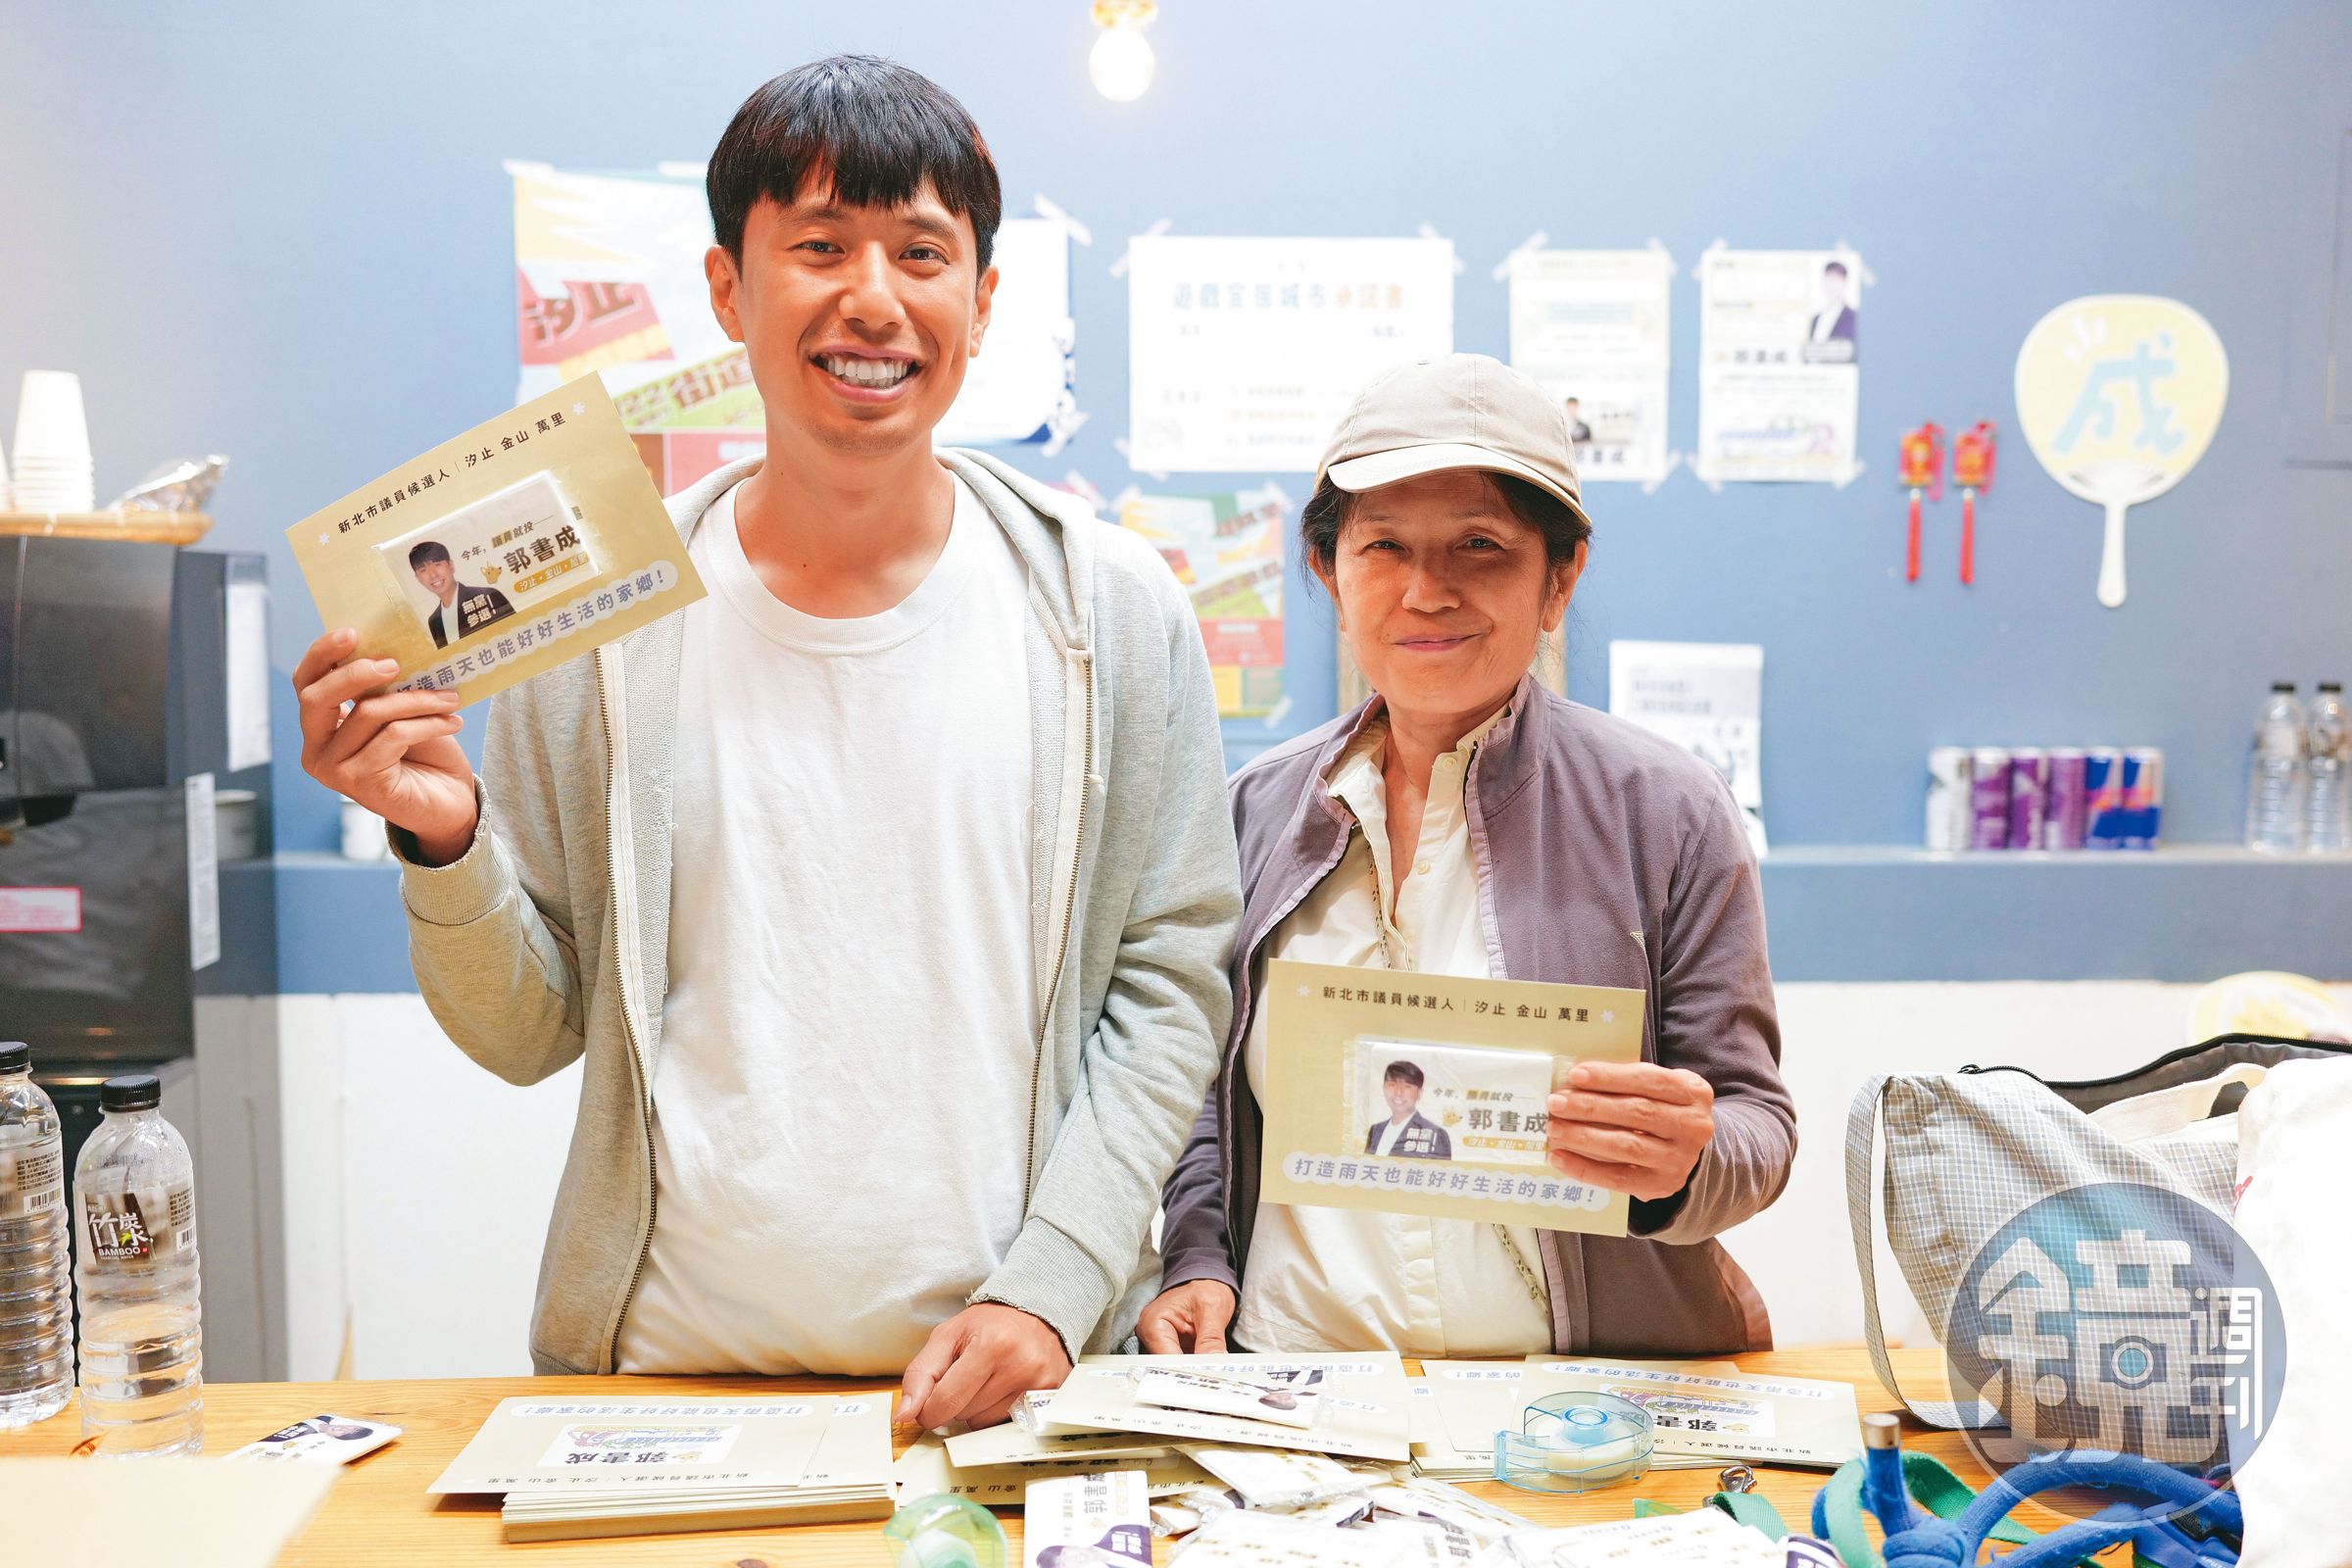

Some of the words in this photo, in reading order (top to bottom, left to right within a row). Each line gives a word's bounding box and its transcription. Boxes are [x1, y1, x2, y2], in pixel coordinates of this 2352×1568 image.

[2051, 331, 2187, 456] 成
[337, 468, 452, 535] 新北市議員候選人
[465, 447, 495, 468] 汐止
[501, 429, 530, 453] 金山
[535, 412, 567, 434] 萬里
[503, 524, 581, 575] 郭書成
[1322, 985, 1455, 1011] 新北市議員候選人
[1474, 1001, 1507, 1017] 汐止
[1516, 1004, 1548, 1020] 金山
[1557, 1007, 1591, 1023] 萬里
[1468, 1108, 1548, 1134] 郭書成
[1294, 1157, 1596, 1203] 打造雨天也能好好生活的家鄉！
[98, 1247, 141, 1256] BAMBOO
[524, 1404, 805, 1417] 打造雨天也能好好生活的家鄉！
[565, 1449, 673, 1466] 郭書成
[988, 1483, 1017, 1494] 金山
